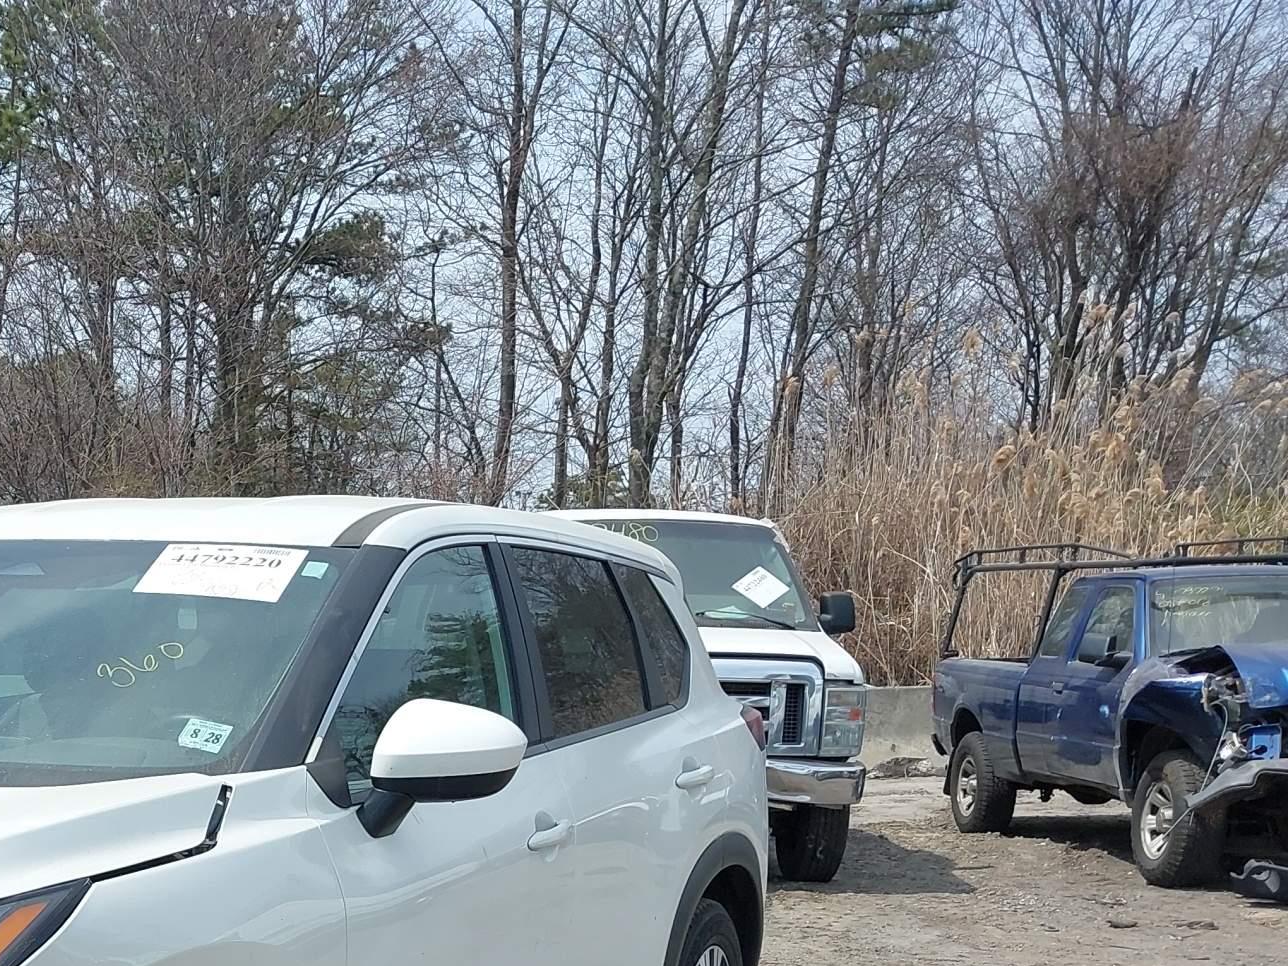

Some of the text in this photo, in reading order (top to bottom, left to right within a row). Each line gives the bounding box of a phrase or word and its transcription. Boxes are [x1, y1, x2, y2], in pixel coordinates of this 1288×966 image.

[171, 554, 282, 568] 44792220
[97, 642, 184, 687] 360
[189, 728, 201, 739] 8
[203, 731, 223, 745] 28
